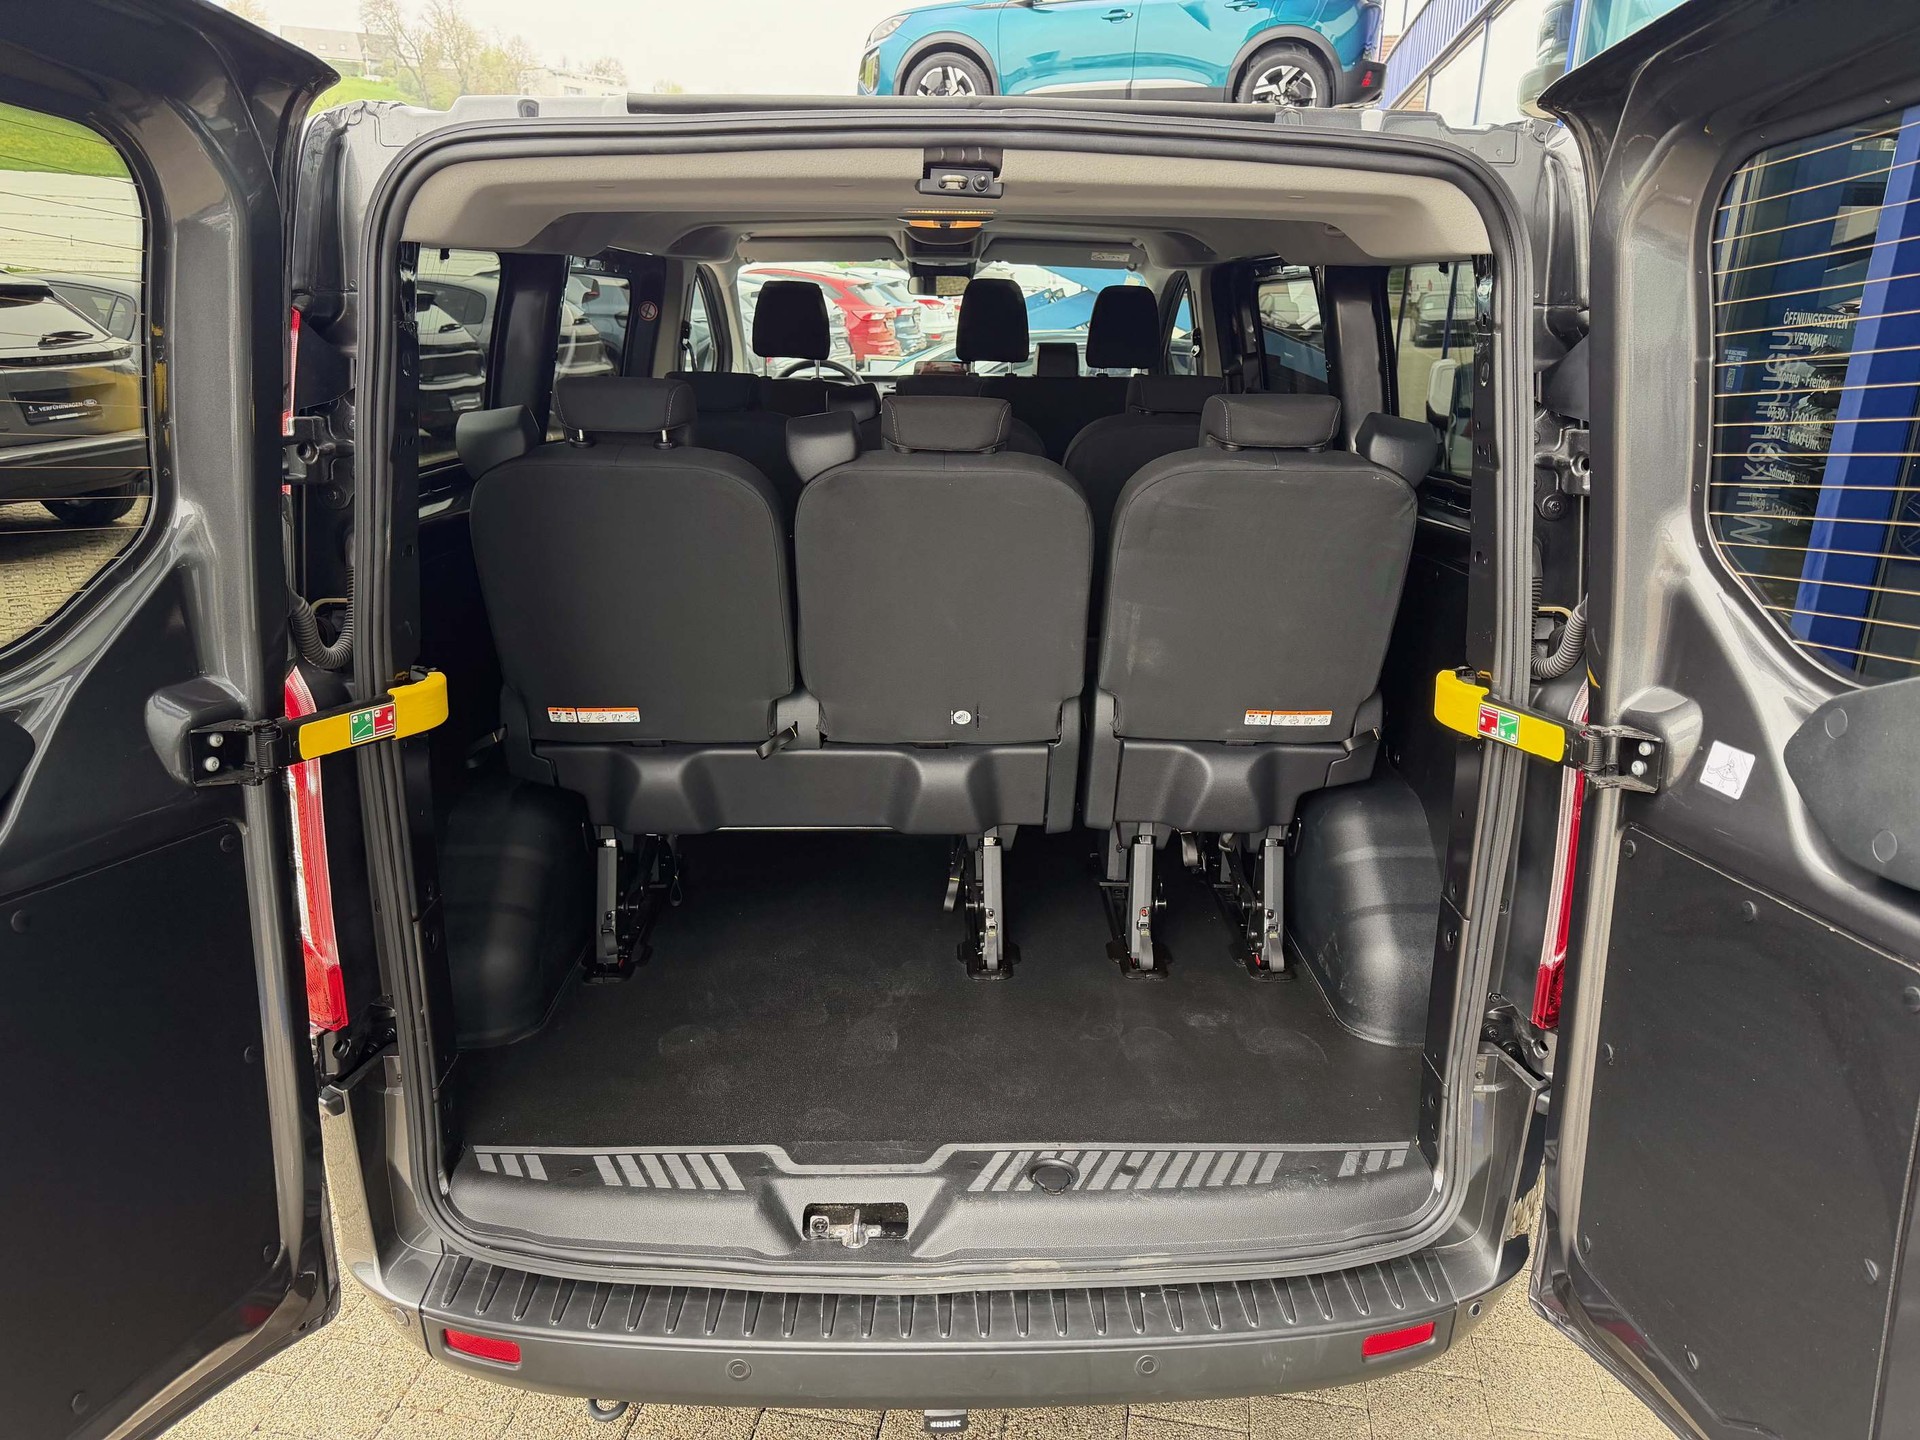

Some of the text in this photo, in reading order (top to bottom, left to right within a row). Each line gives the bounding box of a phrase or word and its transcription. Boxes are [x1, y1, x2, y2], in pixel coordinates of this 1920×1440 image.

[1783, 308, 1849, 329] ÖFFNUNGSZEITEN
[1794, 332, 1828, 348] VERKAUF
[1805, 373, 1830, 394] Freitag
[1769, 463, 1795, 485] Samstag
